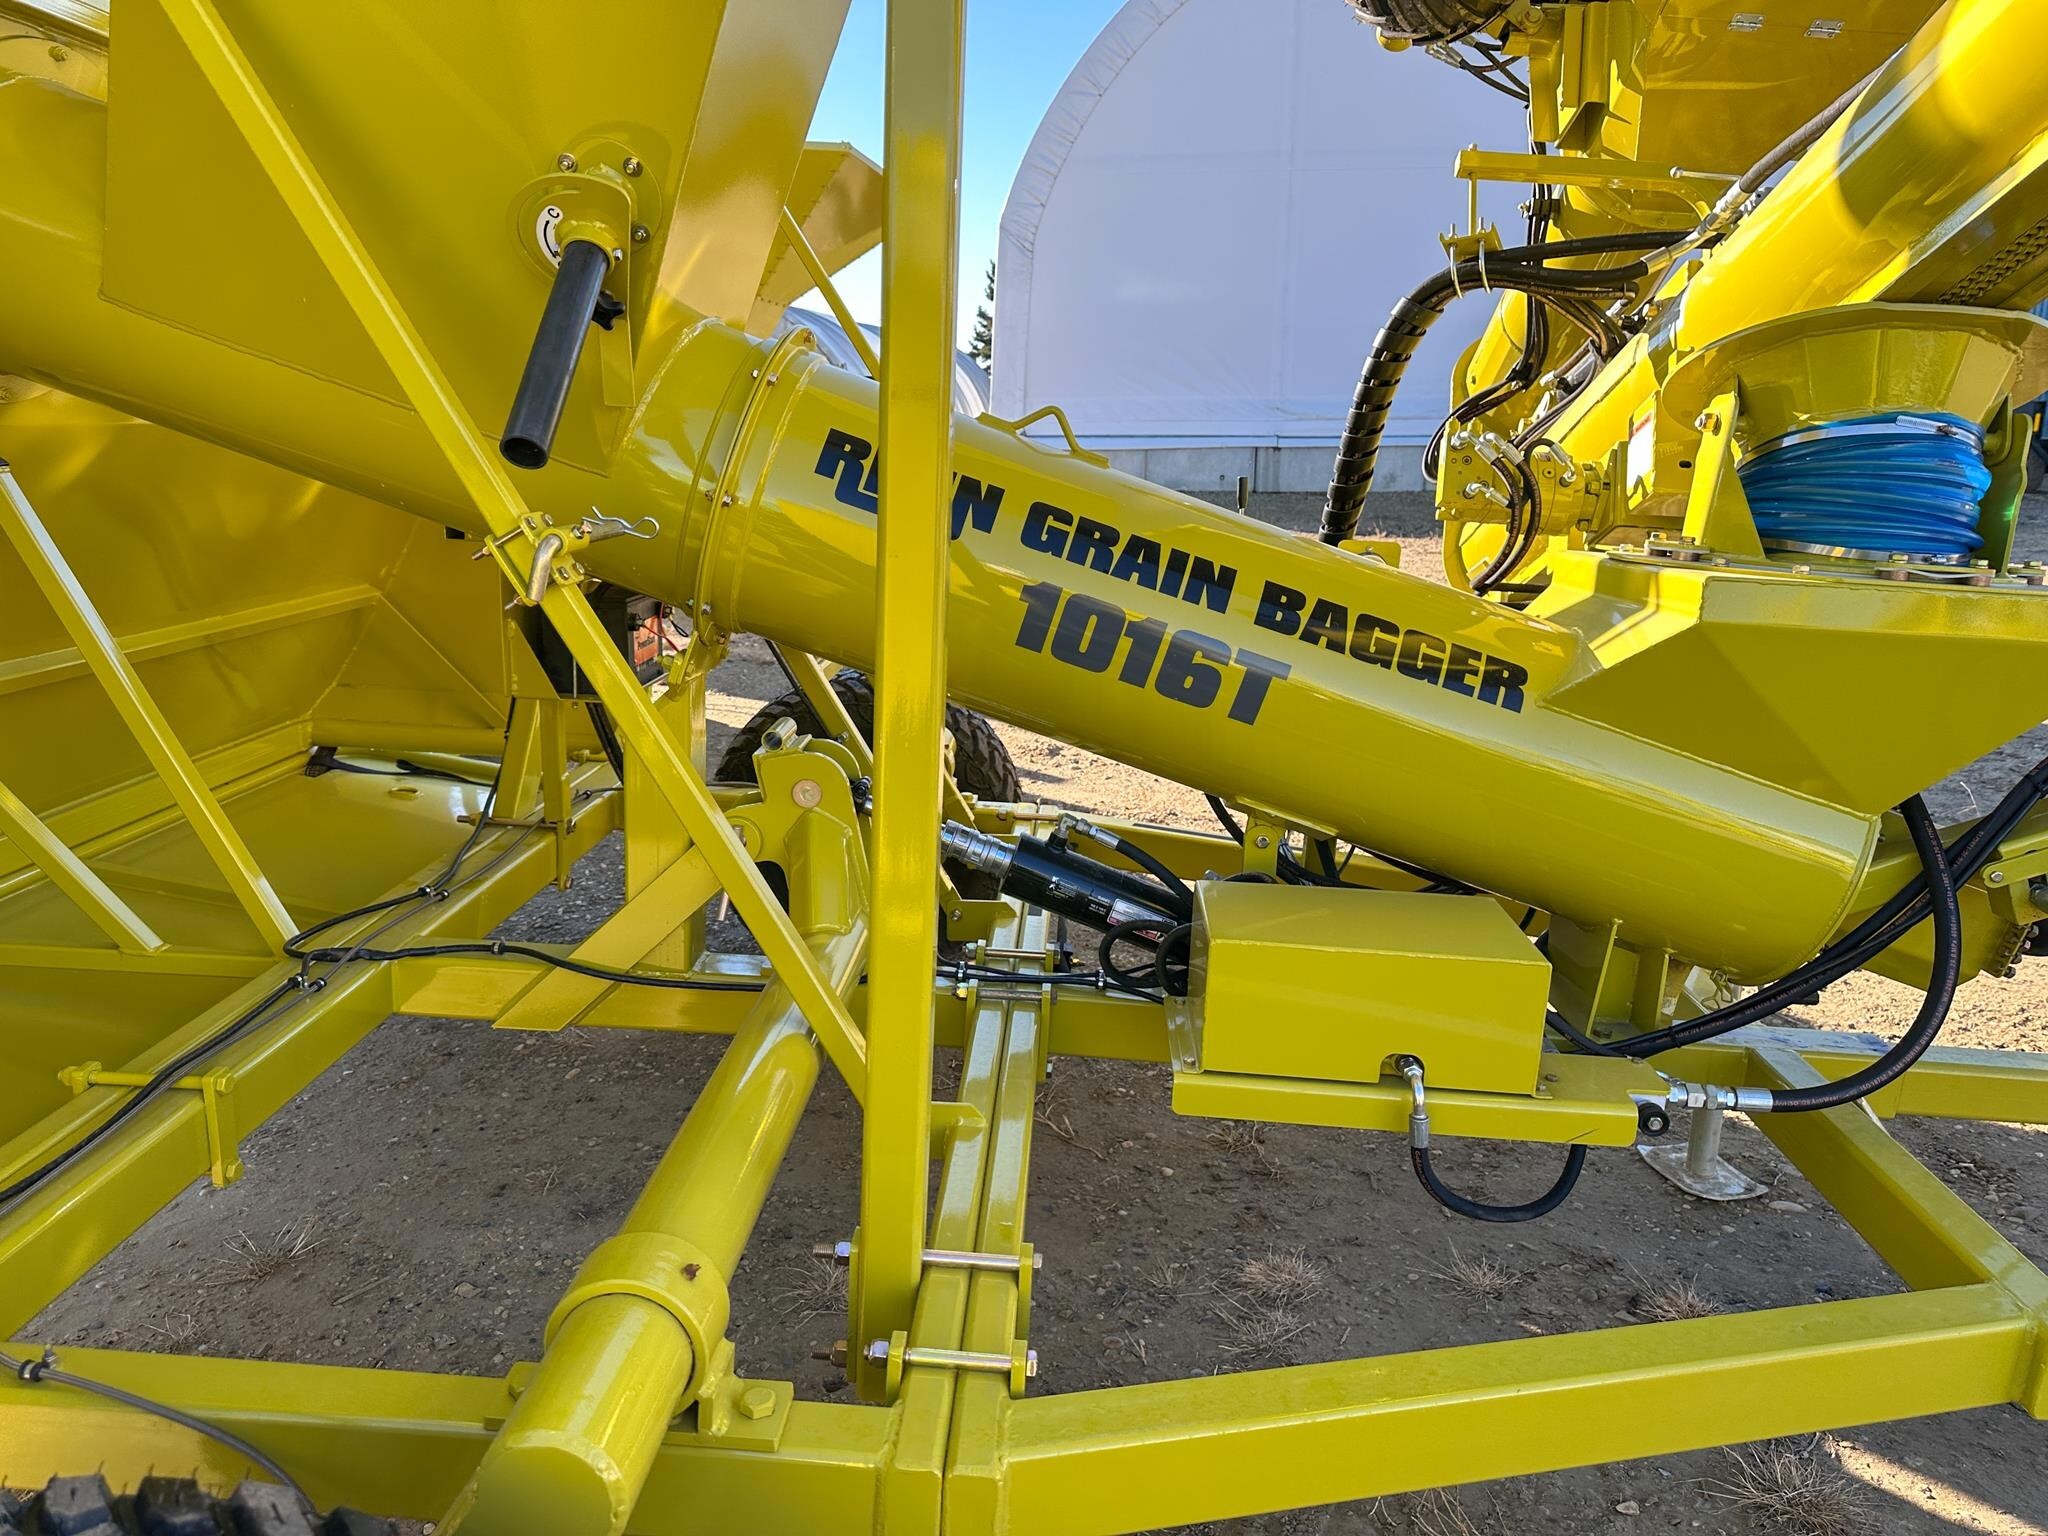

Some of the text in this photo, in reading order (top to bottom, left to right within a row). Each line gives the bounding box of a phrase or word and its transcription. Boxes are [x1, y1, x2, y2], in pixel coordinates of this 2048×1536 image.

[814, 427, 1529, 713] RN GRAIN BAGGER
[1015, 581, 1292, 726] 1016T
